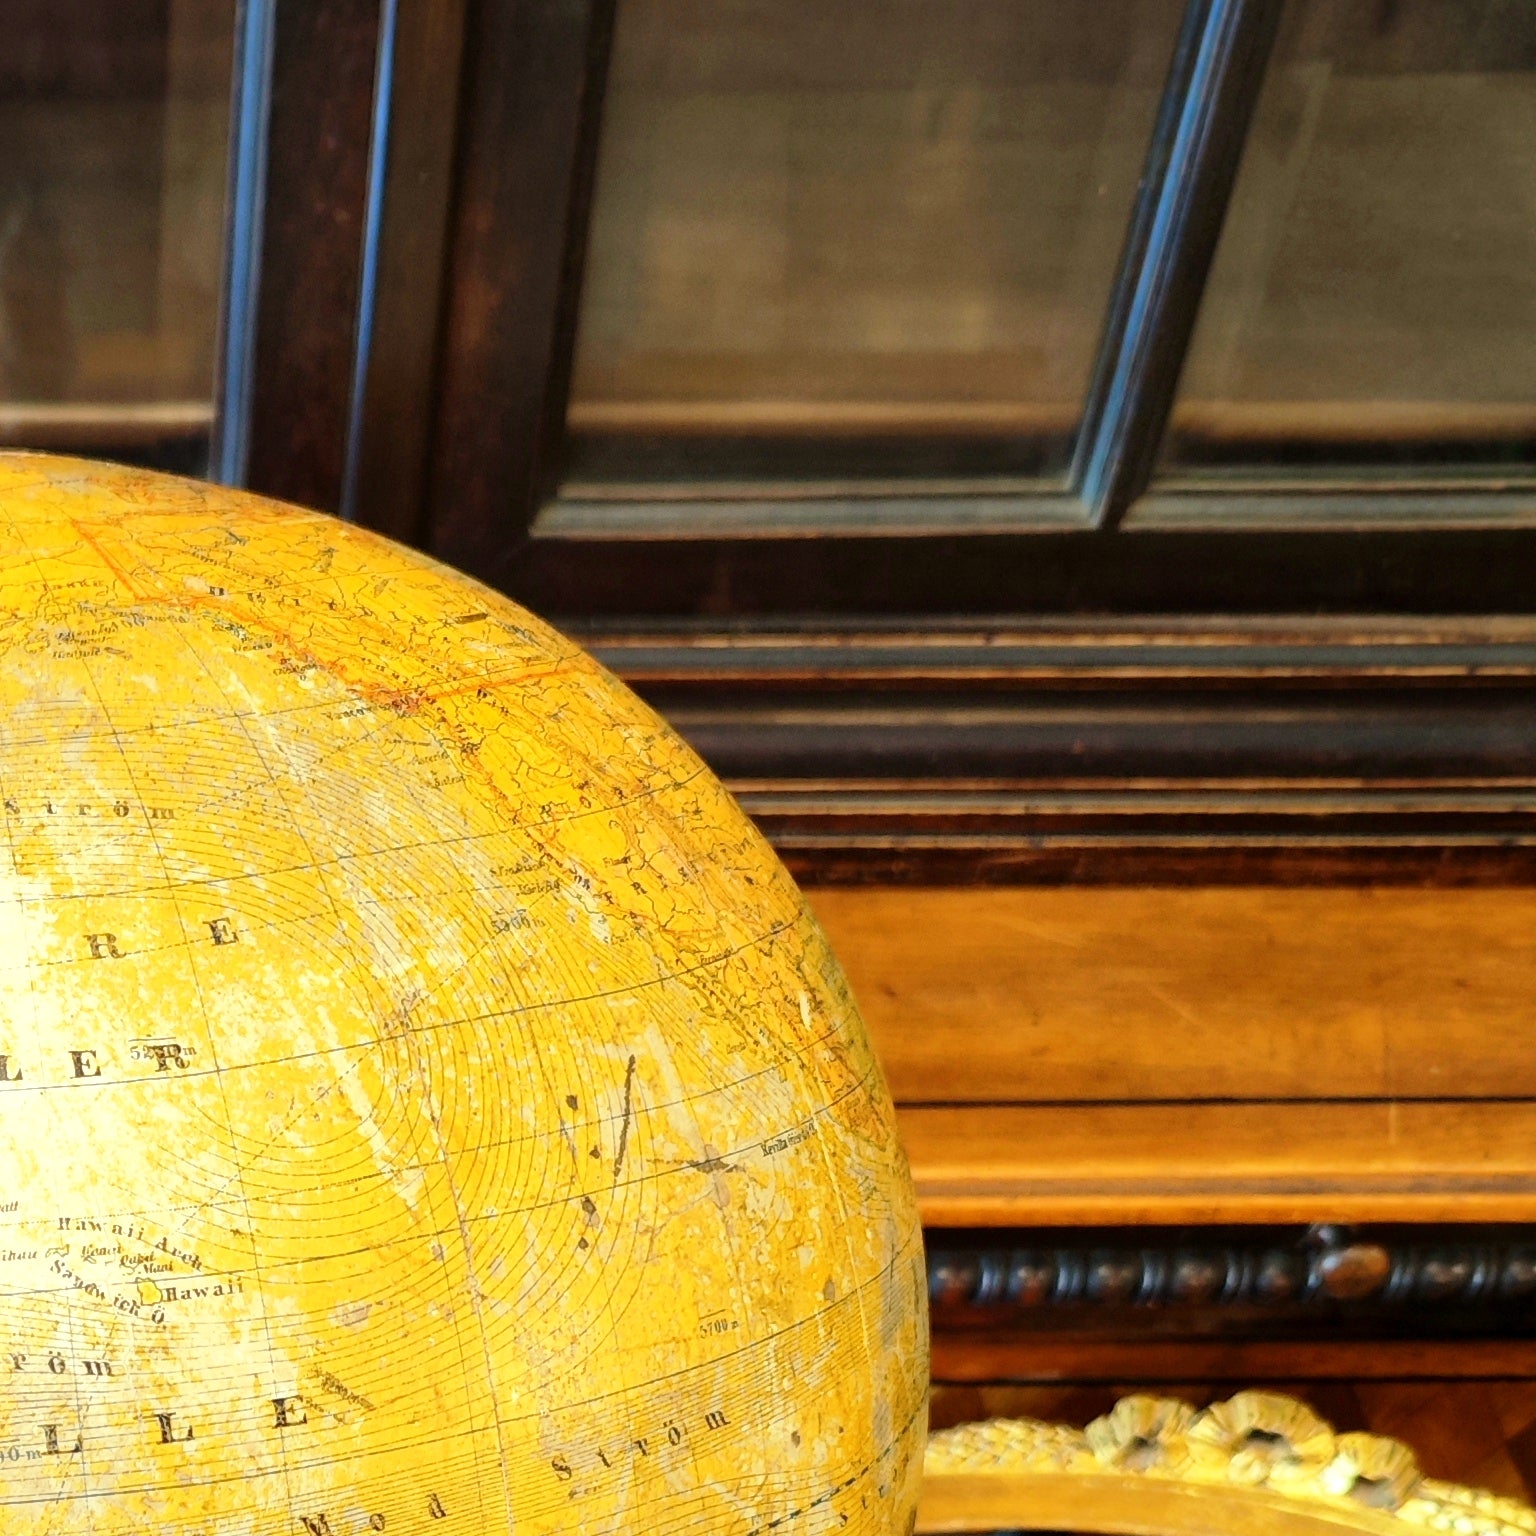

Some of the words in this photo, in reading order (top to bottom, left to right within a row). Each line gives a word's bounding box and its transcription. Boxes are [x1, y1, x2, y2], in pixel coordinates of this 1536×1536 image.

[4, 798, 175, 819] Ström
[164, 1276, 244, 1303] Hawaii
[550, 1409, 731, 1482] Ström
